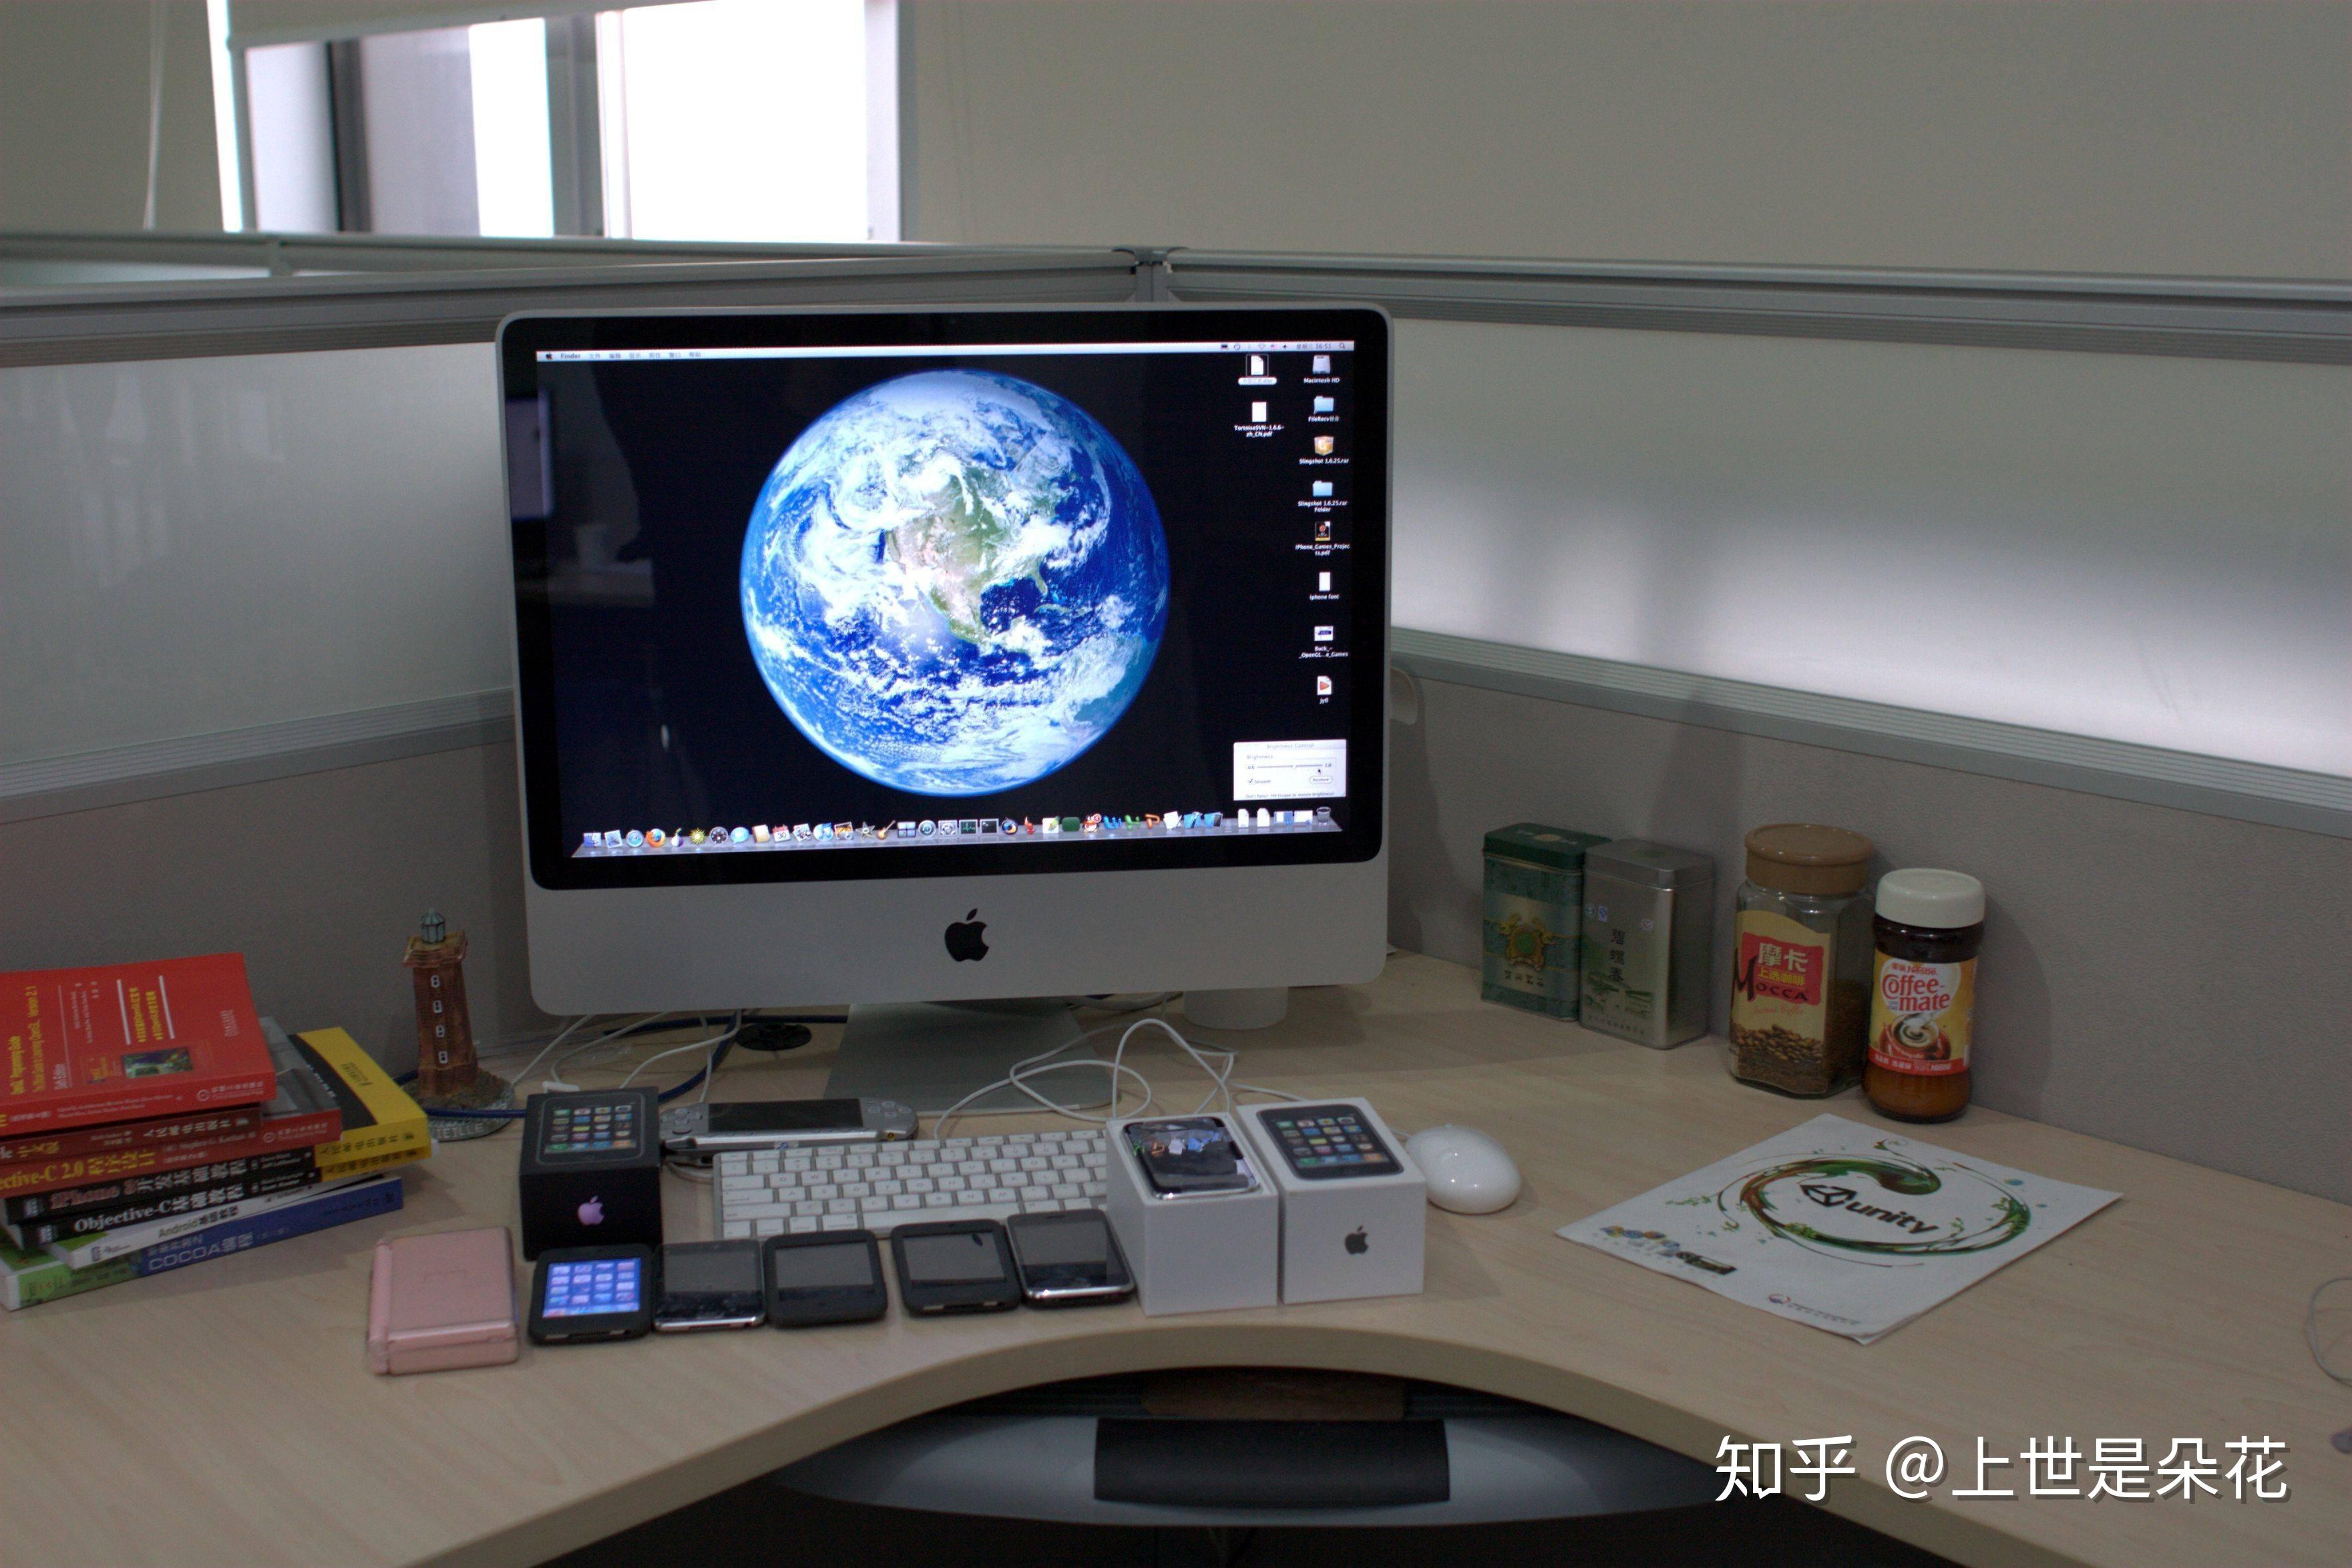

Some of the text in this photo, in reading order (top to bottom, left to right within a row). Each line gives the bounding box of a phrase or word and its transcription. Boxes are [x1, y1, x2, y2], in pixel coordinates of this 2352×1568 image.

[1757, 942, 1809, 973] 摩卡
[1757, 966, 1806, 986] 上选咖啡
[1899, 993, 1951, 1011] mate
[436, 1123, 484, 1139] IEILLE
[61, 1160, 85, 1179] 2.0
[50, 1185, 122, 1210] iPhone
[1845, 1201, 1939, 1234] unity
